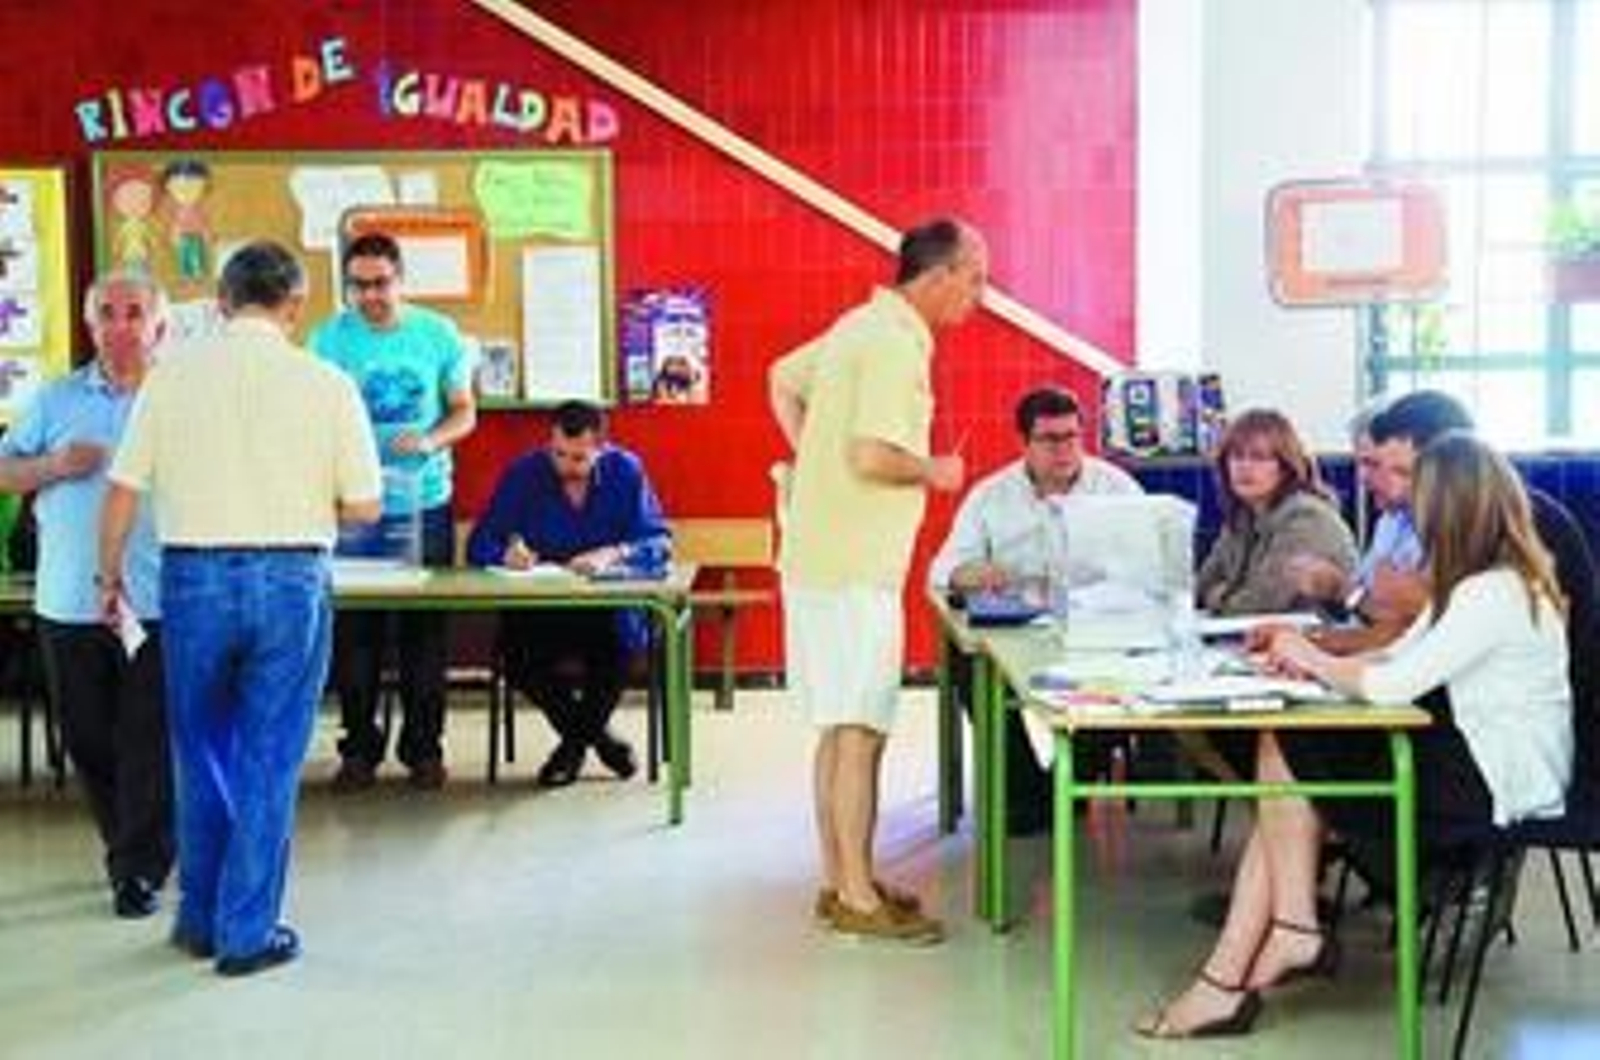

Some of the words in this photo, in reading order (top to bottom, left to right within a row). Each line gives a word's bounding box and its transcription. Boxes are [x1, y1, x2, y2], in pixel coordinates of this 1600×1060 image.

[75, 66, 275, 141] RINCON
[293, 38, 353, 102] DE
[379, 65, 619, 142] IGUALDAD
